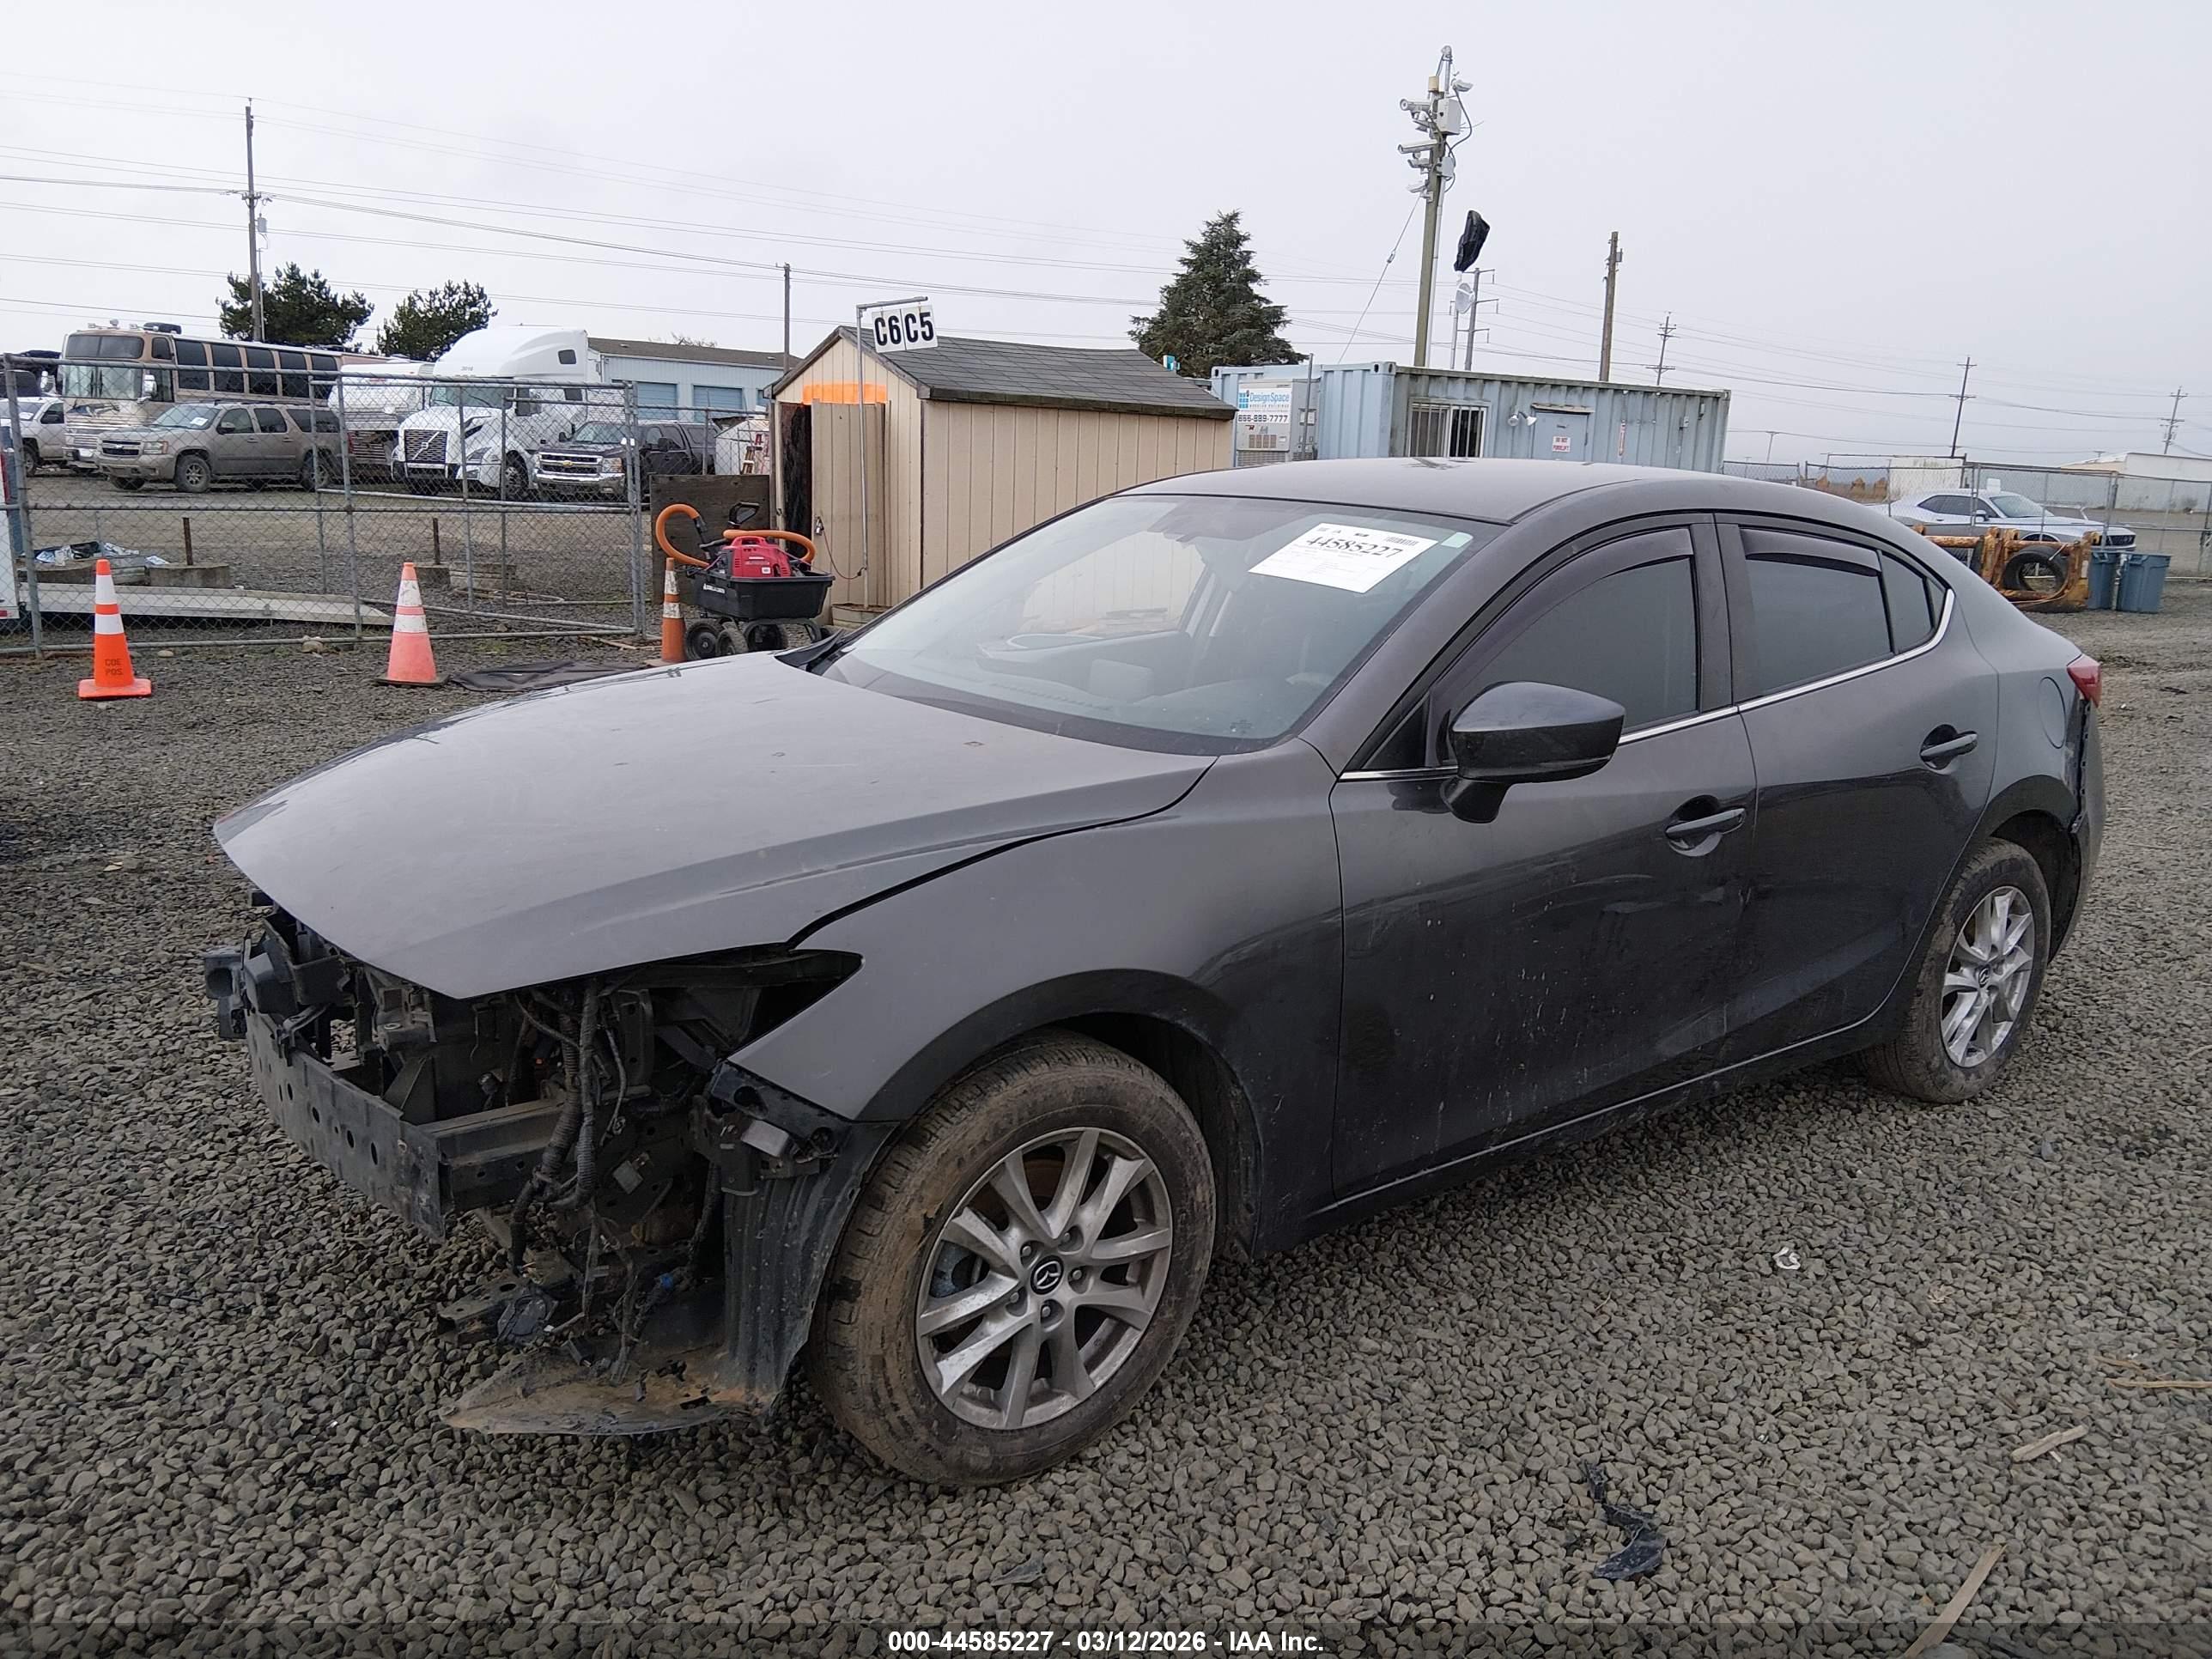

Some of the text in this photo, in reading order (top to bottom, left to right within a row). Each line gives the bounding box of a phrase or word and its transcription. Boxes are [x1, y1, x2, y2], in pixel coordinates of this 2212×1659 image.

[874, 312, 934, 346] C6 C5
[1306, 536, 1403, 557] 44585227
